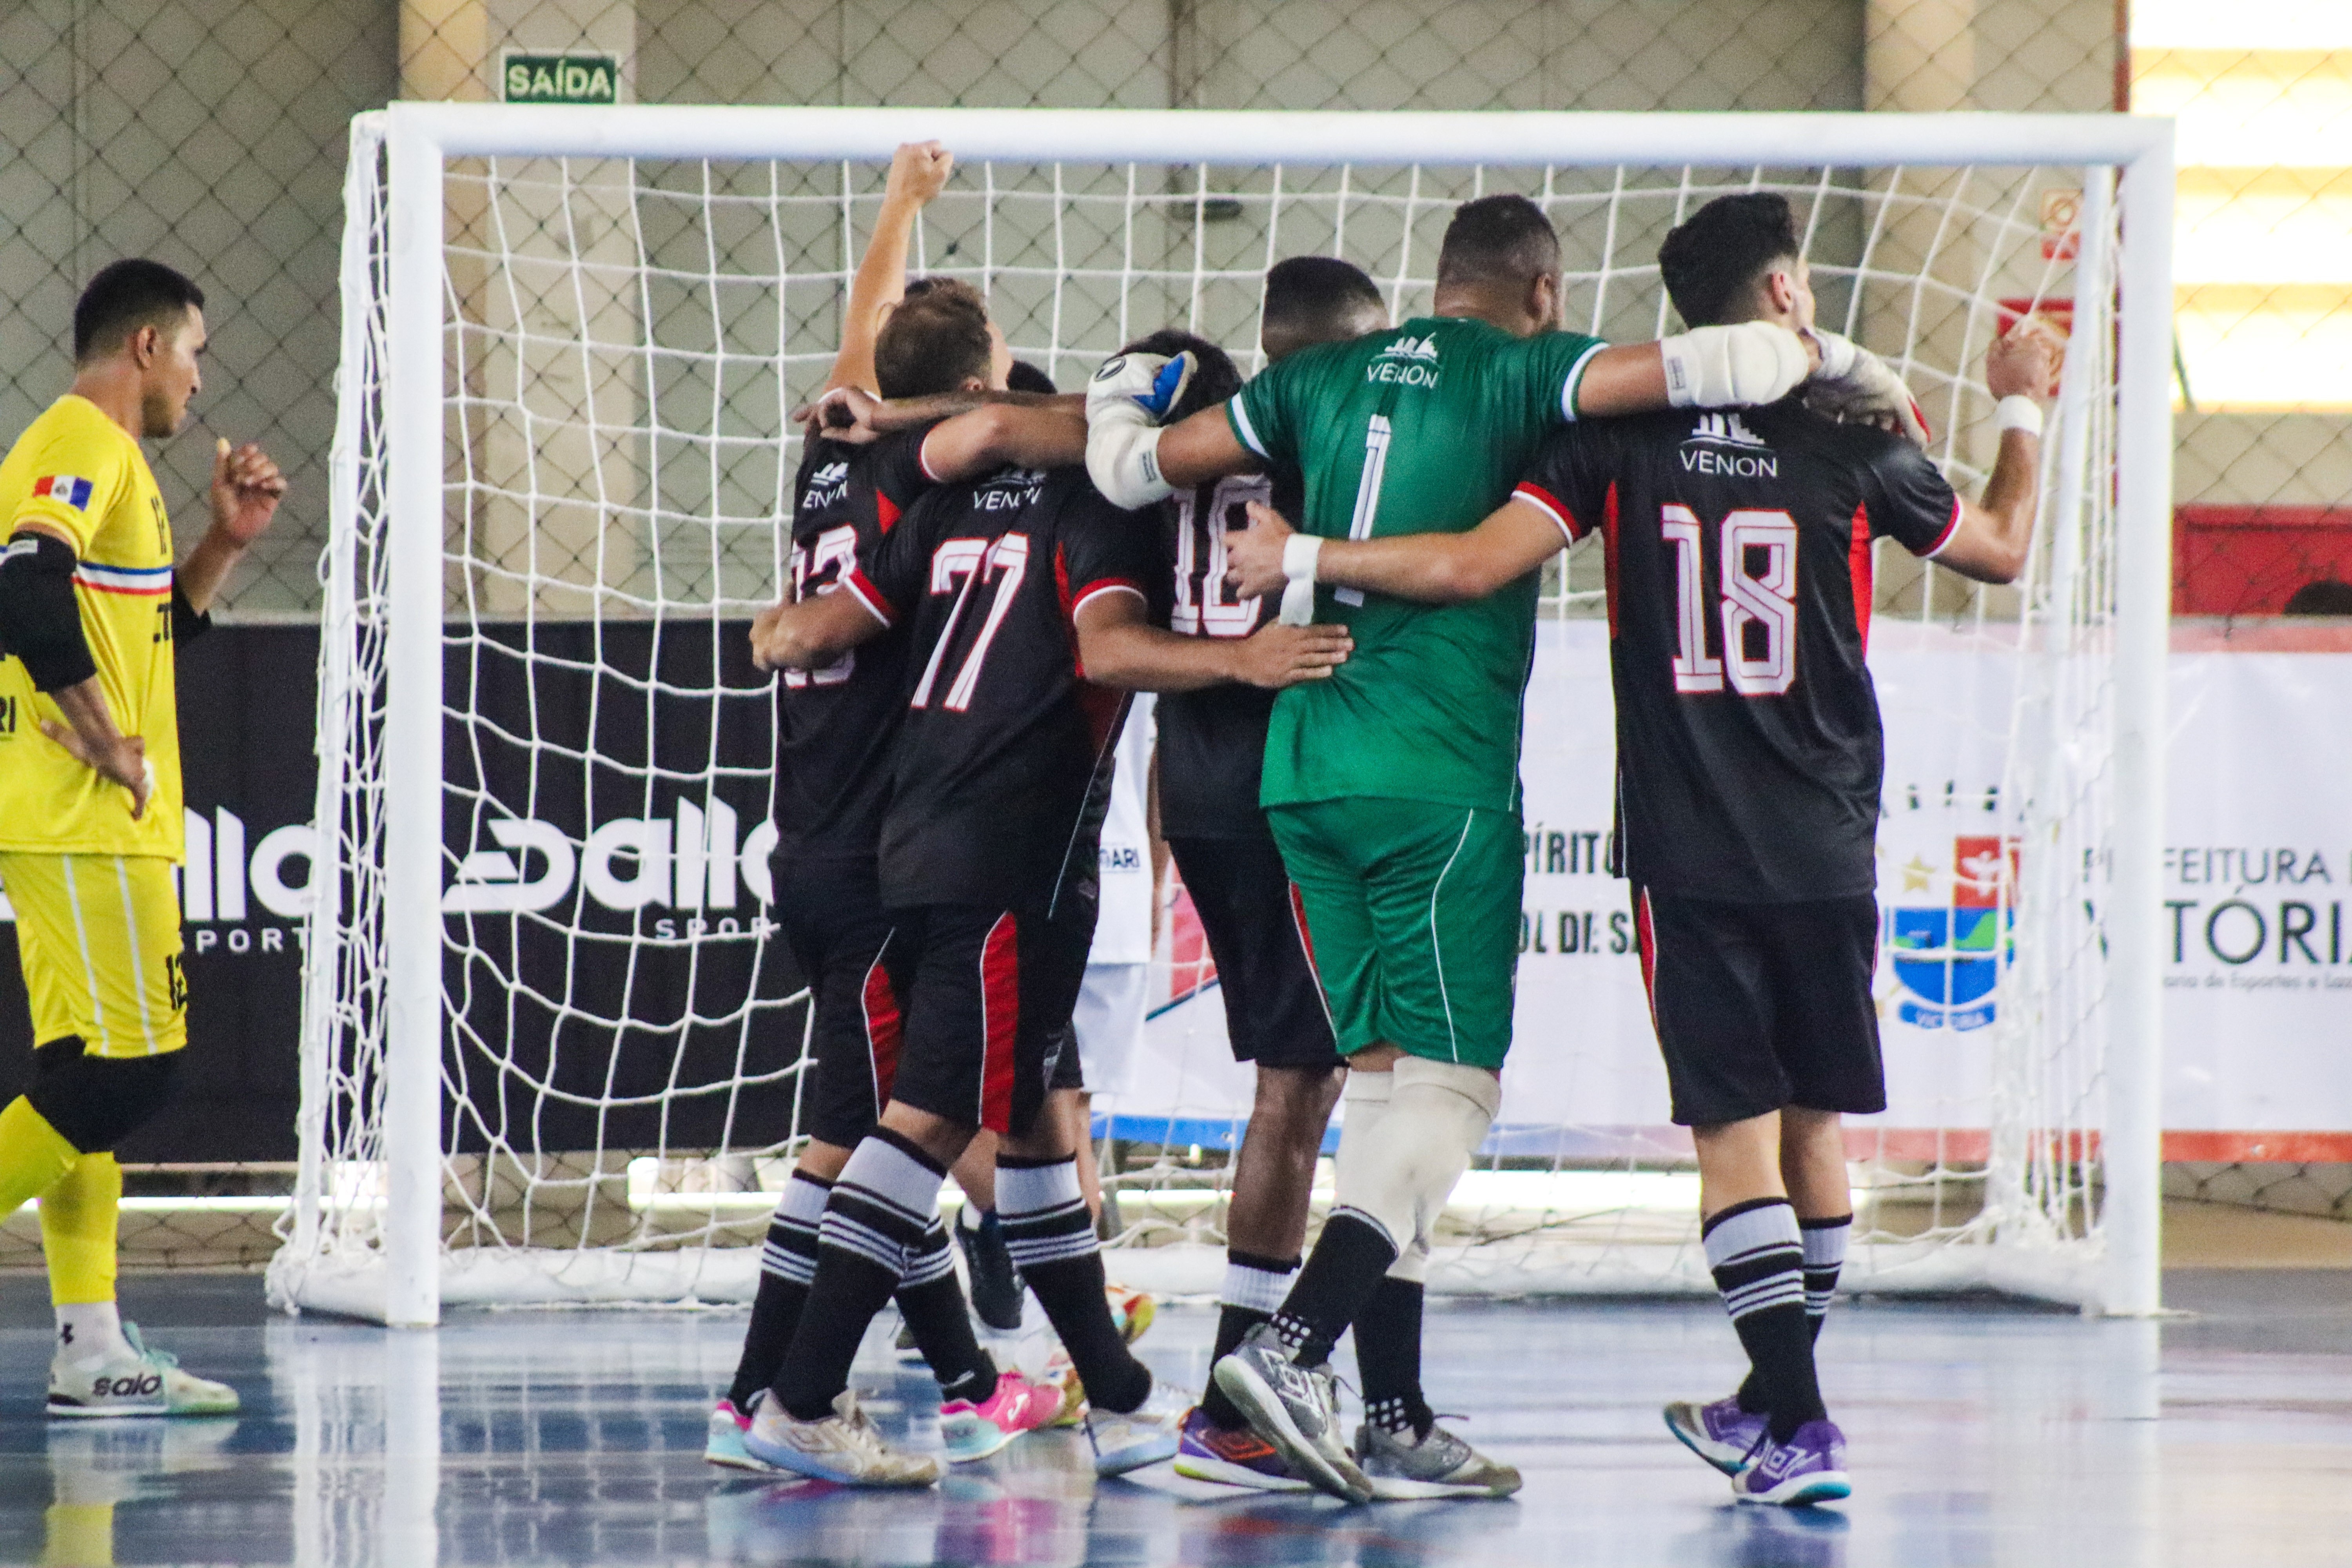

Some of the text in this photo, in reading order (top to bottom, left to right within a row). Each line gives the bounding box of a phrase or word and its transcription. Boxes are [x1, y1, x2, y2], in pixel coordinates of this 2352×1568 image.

[507, 58, 612, 97] SAÍDA
[1367, 362, 1438, 389] VENON
[1680, 450, 1777, 477] VENON
[973, 486, 1042, 510] VENN
[1661, 502, 1798, 697] 18
[911, 530, 1030, 713] 77
[179, 927, 310, 954] PORT
